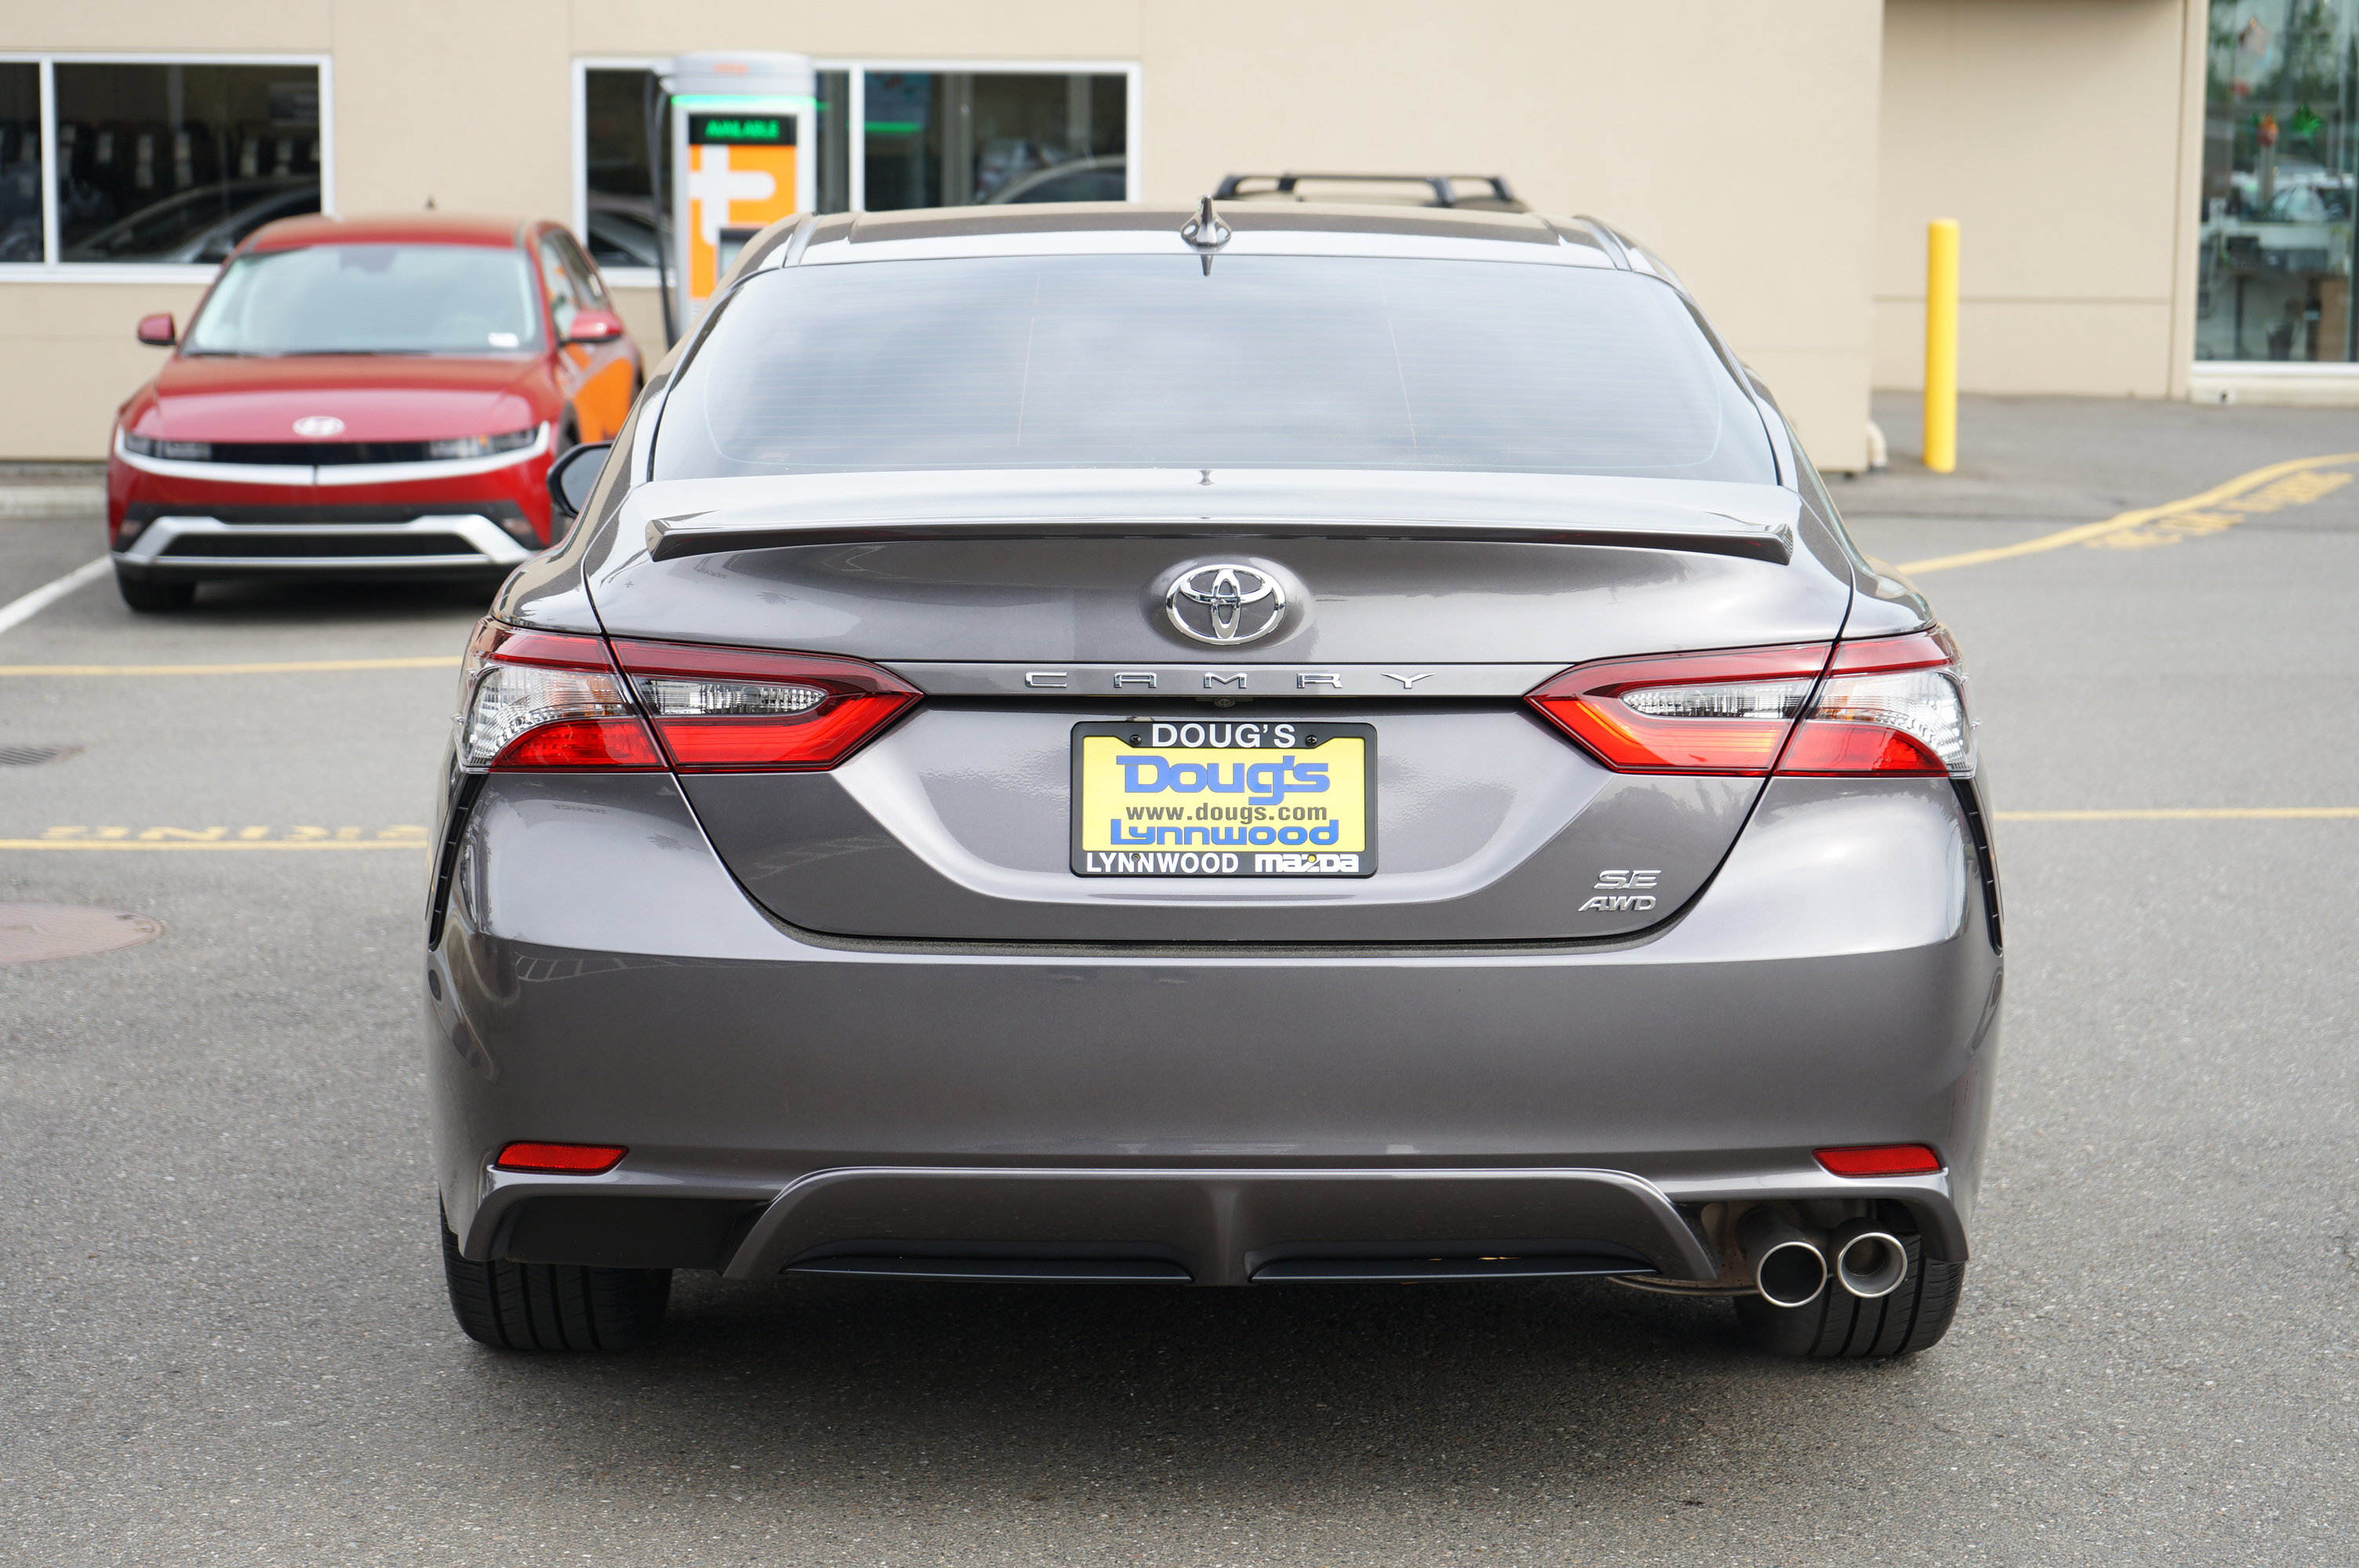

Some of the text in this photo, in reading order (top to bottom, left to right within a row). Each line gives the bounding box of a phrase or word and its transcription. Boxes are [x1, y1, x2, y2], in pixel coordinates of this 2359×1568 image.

[1025, 672, 1435, 689] CAMRY
[1152, 723, 1296, 748] DOUG'S
[1116, 755, 1330, 805] Doug's
[1125, 802, 1327, 824] www.dougs.com
[1110, 818, 1339, 845] Lynnwood
[1087, 852, 1238, 873] LYNNWOOD
[1594, 869, 1661, 889] SE
[1578, 895, 1656, 912] AWD
